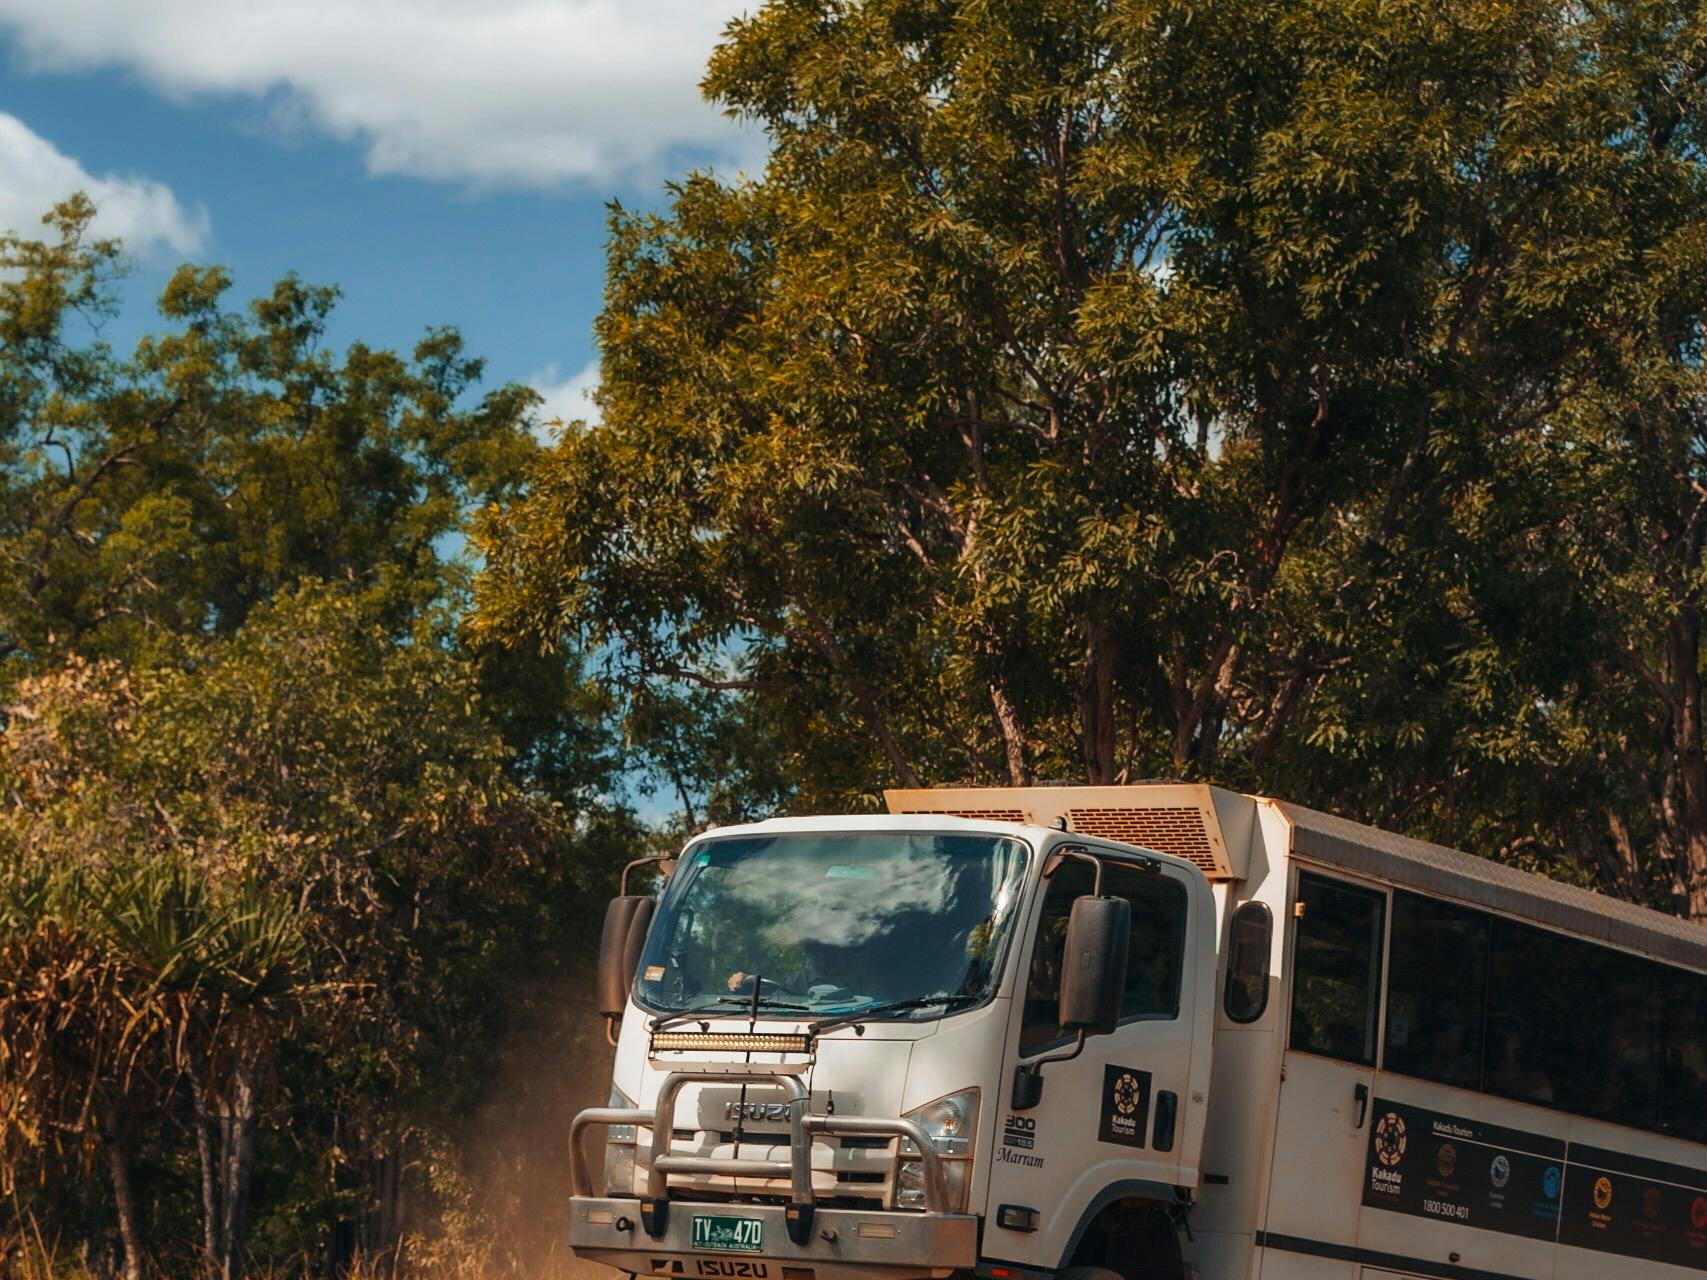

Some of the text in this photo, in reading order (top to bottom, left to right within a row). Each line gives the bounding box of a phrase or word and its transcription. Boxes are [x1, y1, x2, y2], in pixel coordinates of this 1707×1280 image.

[725, 1102, 791, 1122] ISUZ
[1112, 1114, 1136, 1127] Kakadu
[1004, 1114, 1036, 1131] 300
[1111, 1123, 1135, 1136] Tourism
[1433, 1121, 1473, 1138] Kakadu Tourism
[996, 1147, 1044, 1168] Marram
[1371, 1166, 1402, 1183] Kakadu
[1371, 1179, 1401, 1195] Tourism
[1423, 1199, 1470, 1219] 1800 500 401
[694, 1218, 712, 1242] TV
[696, 1260, 768, 1278] ISUZU
